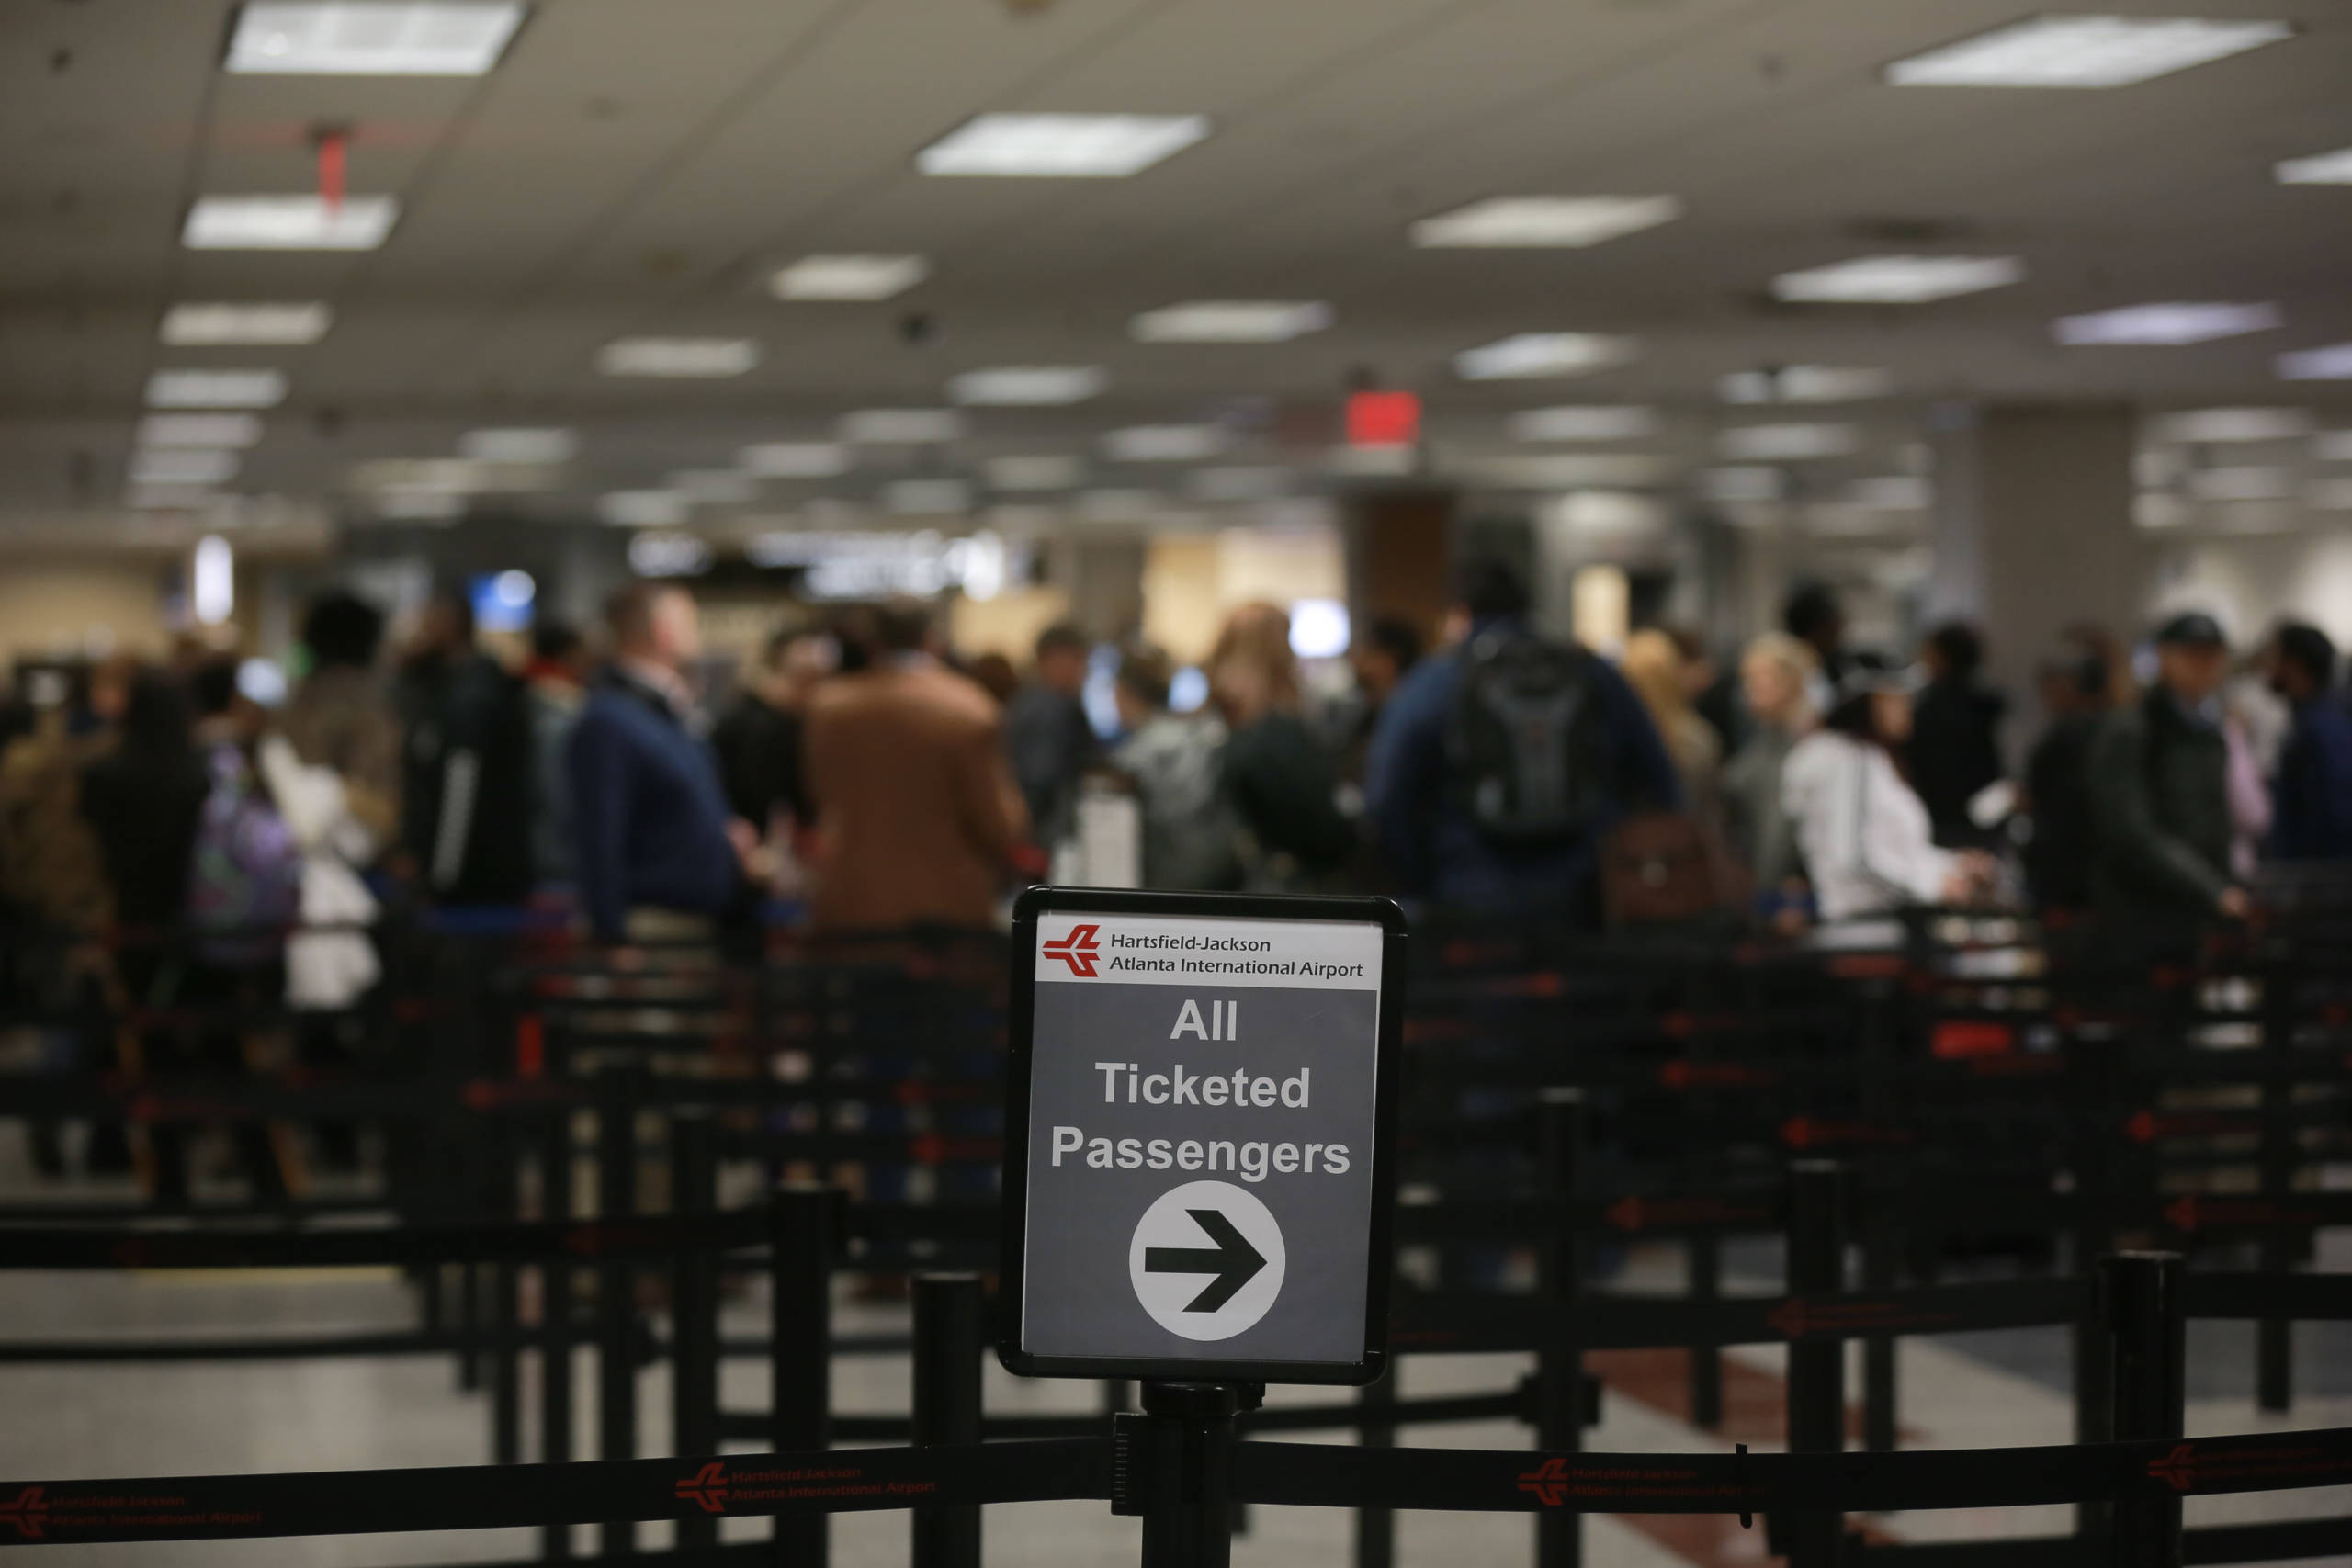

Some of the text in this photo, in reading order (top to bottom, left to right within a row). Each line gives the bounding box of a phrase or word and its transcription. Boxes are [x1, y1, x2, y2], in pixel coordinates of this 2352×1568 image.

[1111, 933, 1271, 952] Hartsfield-Jackson
[1109, 956, 1363, 979] Atlanta International Airport
[1169, 998, 1238, 1041] All
[1094, 1062, 1310, 1108] Ticketed
[1051, 1125, 1351, 1183] Passengers
[731, 1468, 862, 1483] Hartsfield-Jackson
[732, 1482, 935, 1500] Atlanta International Airport
[209, 1510, 263, 1526] Airport
